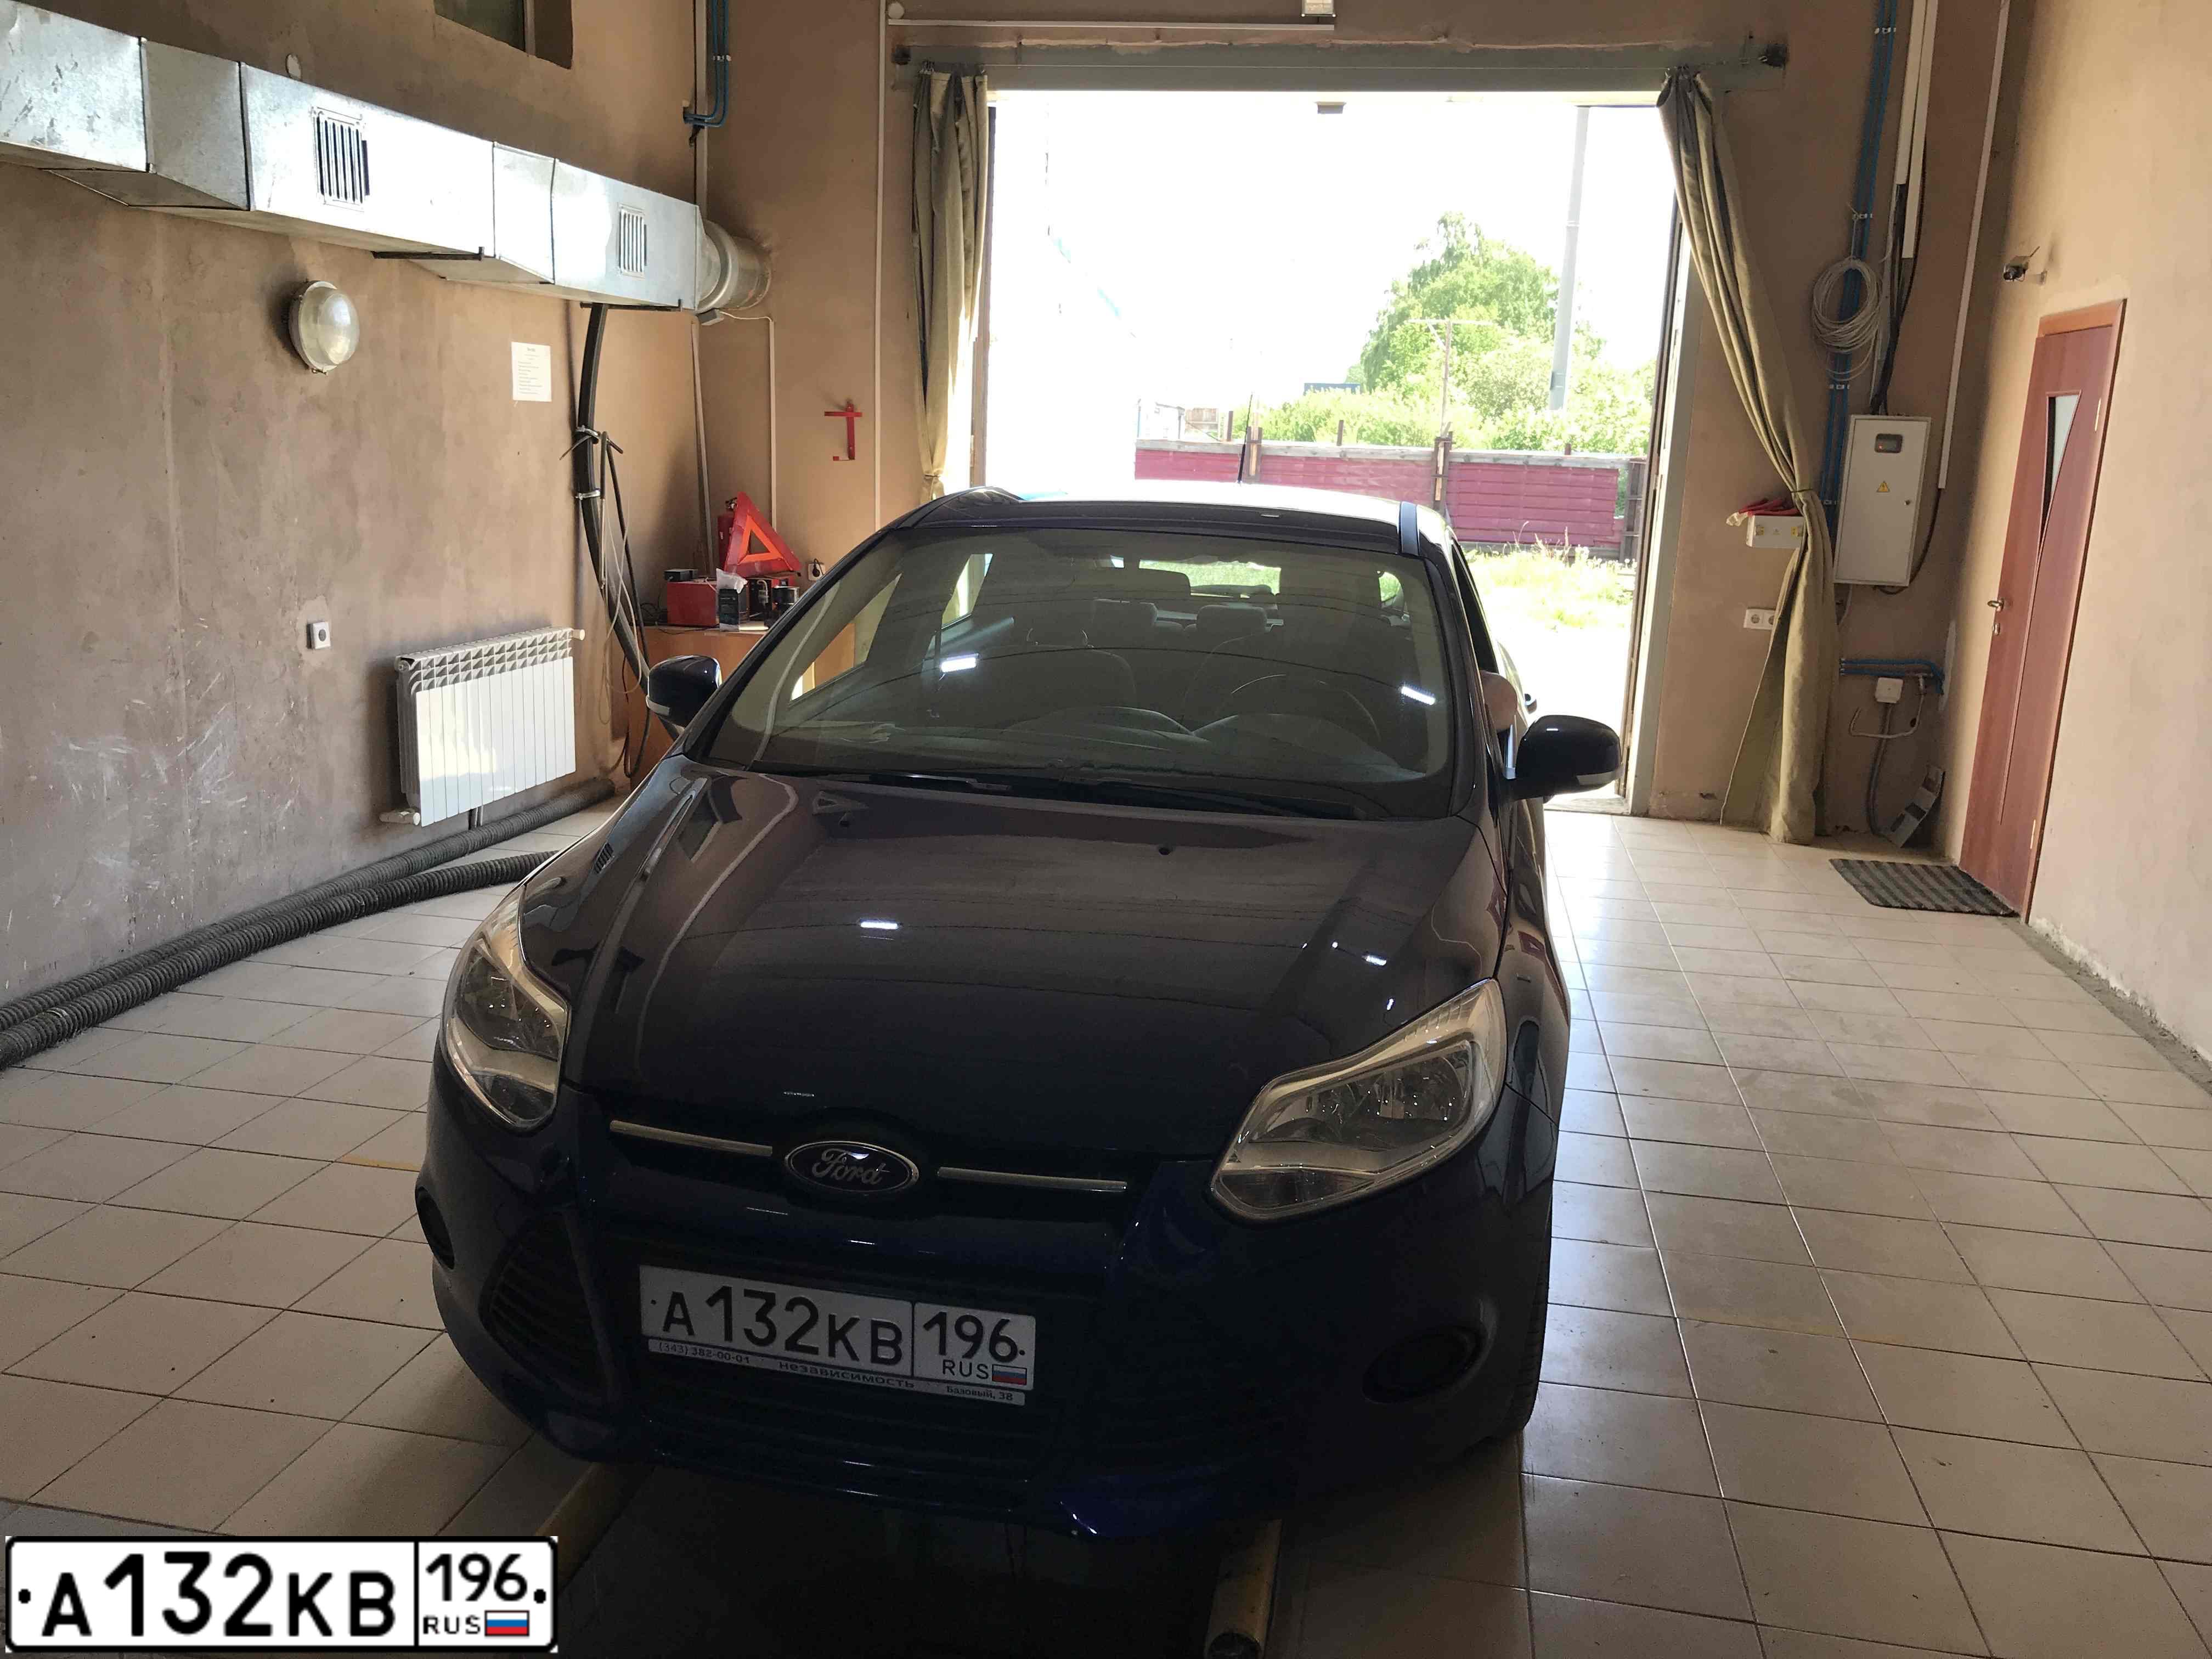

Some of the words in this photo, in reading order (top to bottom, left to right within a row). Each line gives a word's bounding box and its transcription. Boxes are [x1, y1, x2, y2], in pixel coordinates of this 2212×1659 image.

[811, 1148, 887, 1185] Ford
[923, 1311, 1018, 1363] 196
[942, 1359, 989, 1379] RUS
[998, 1391, 1014, 1401] 38
